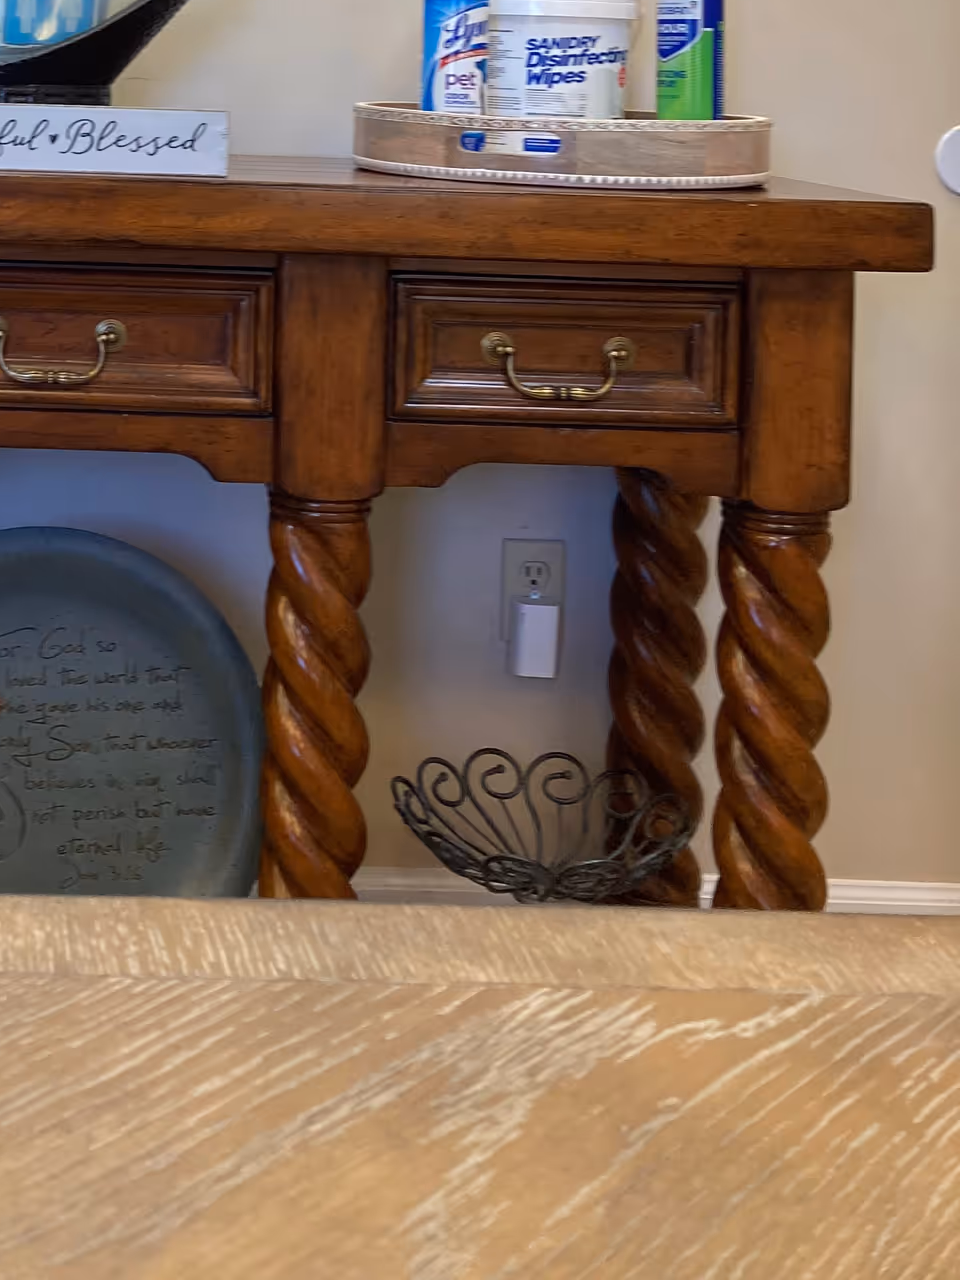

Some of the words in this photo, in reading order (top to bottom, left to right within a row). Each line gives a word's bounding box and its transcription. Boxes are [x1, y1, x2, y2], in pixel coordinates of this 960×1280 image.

[444, 72, 477, 90] pet
[525, 68, 587, 89] Wipes
[58, 119, 208, 156] Blessed
[37, 620, 86, 659] God
[96, 641, 117, 653] so
[5, 668, 47, 686] loved
[95, 659, 138, 685] world
[25, 700, 81, 725] gave
[86, 696, 109, 712] his
[114, 701, 145, 713] one
[24, 769, 95, 790] believes
[57, 832, 122, 855] eternal
